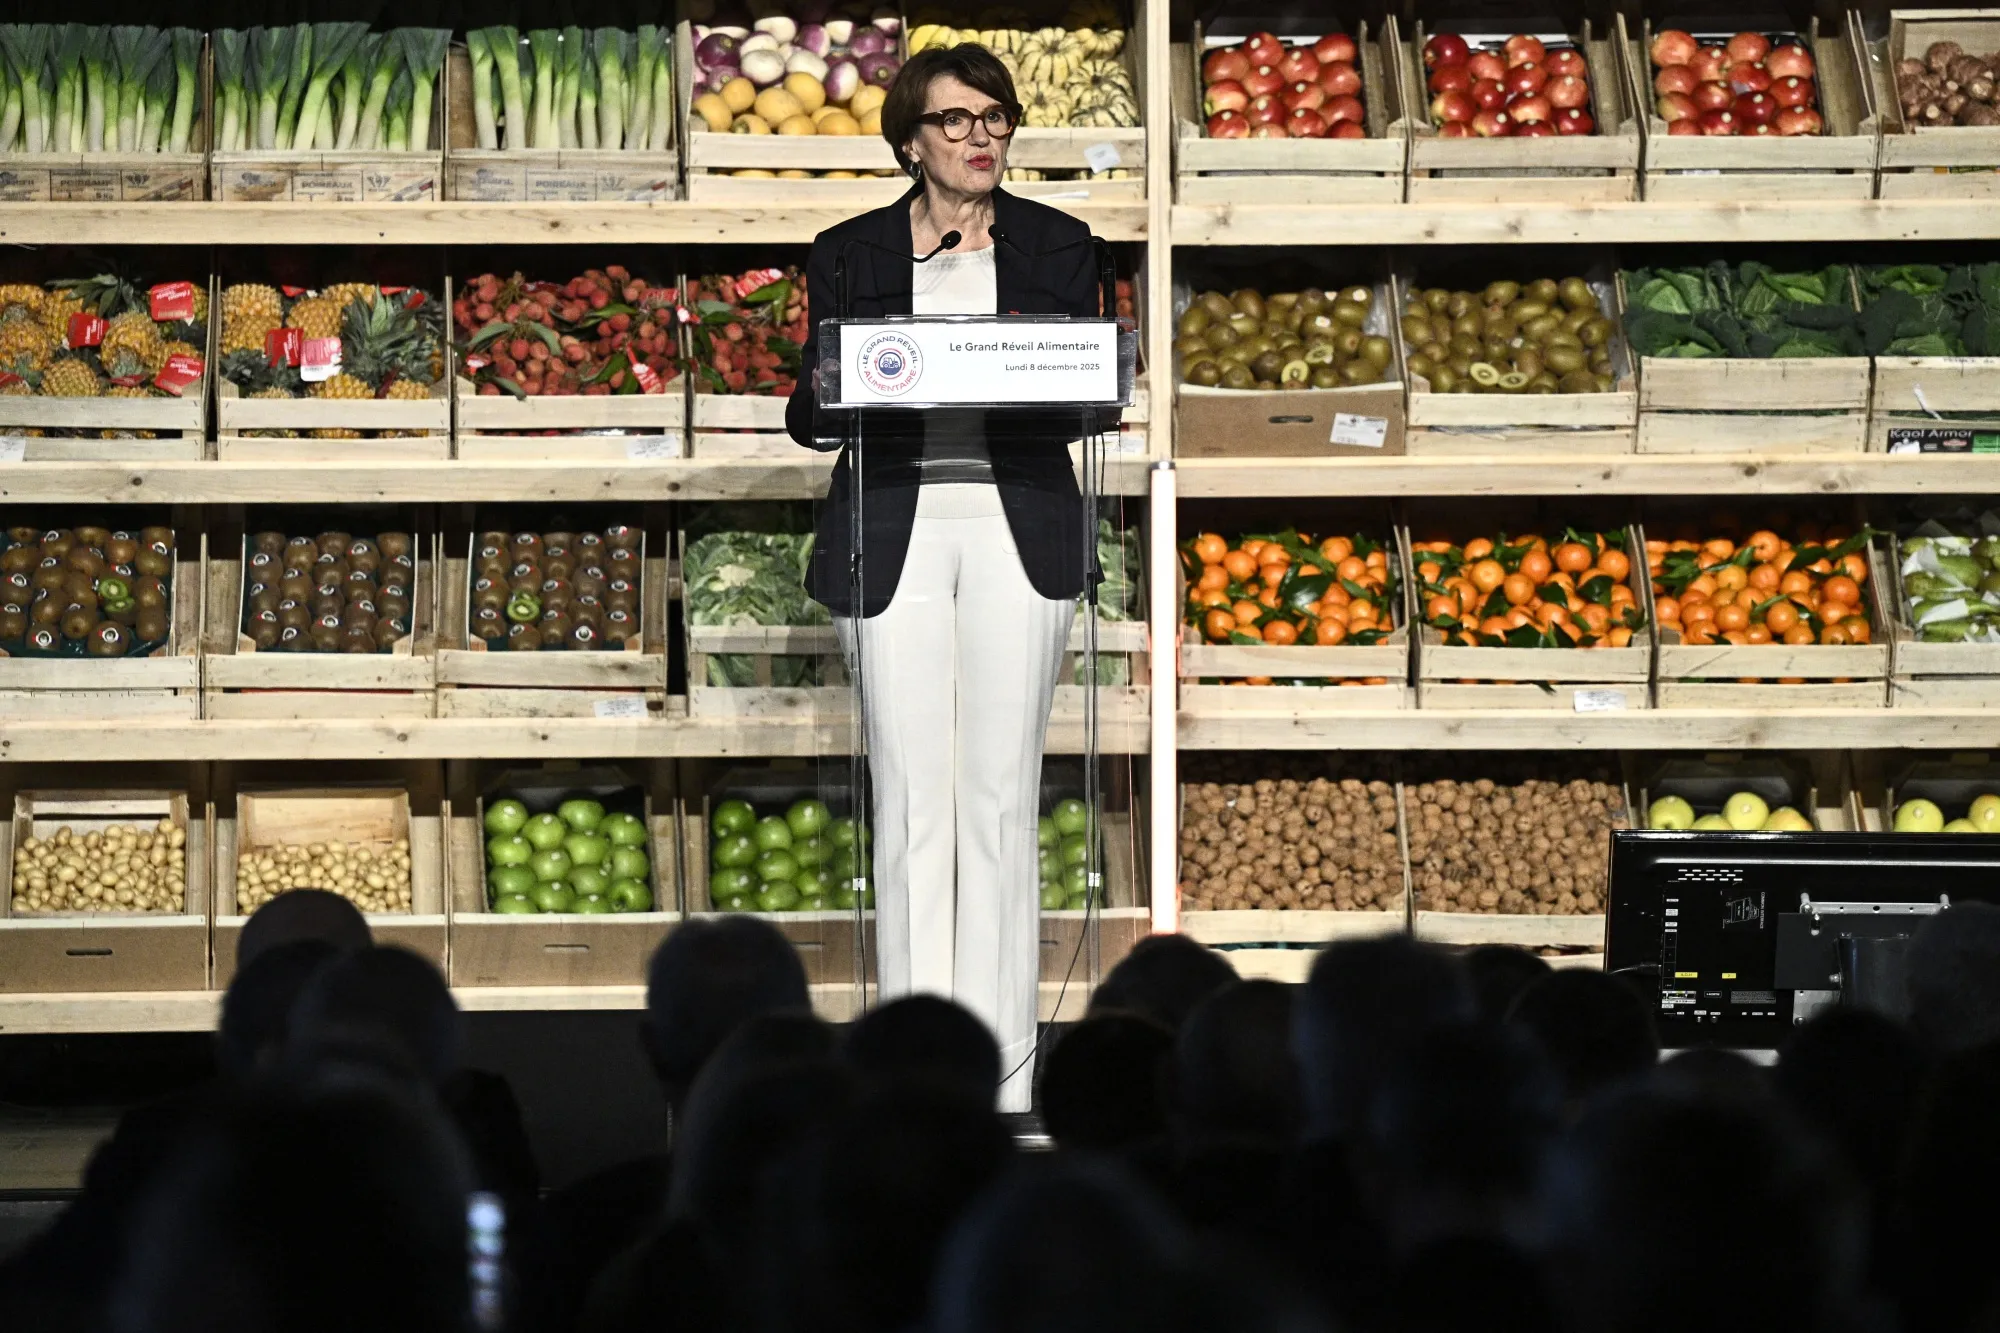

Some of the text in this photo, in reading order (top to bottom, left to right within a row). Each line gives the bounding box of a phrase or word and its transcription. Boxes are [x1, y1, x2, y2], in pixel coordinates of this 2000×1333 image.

[862, 354, 869, 365] LE
[866, 335, 896, 353] GRAND
[950, 341, 1100, 351] Le Grand Réveil Alimentaire
[1005, 363, 1028, 371] Lundi
[1030, 363, 1035, 371] 8
[1037, 363, 1078, 371] décembre
[864, 369, 917, 392] ALIMENTAIRE
[1928, 429, 1972, 439] Armor
